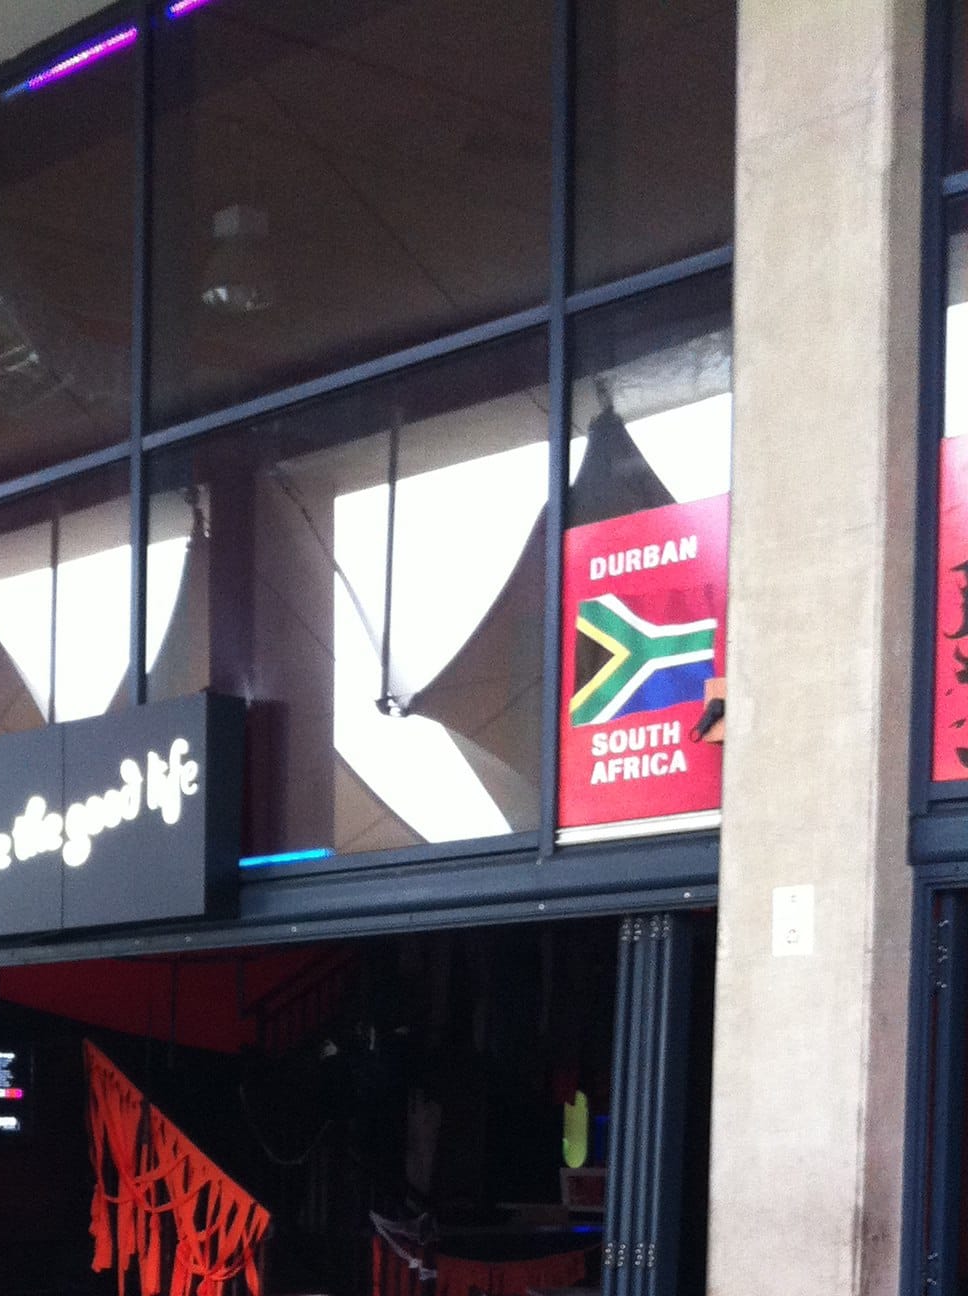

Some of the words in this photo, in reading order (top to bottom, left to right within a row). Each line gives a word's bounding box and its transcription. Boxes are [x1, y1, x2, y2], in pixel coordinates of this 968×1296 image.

[590, 535, 698, 580] DURBAN
[591, 721, 681, 757] SOUTH
[147, 738, 199, 825] life
[590, 751, 687, 785] AFRICA
